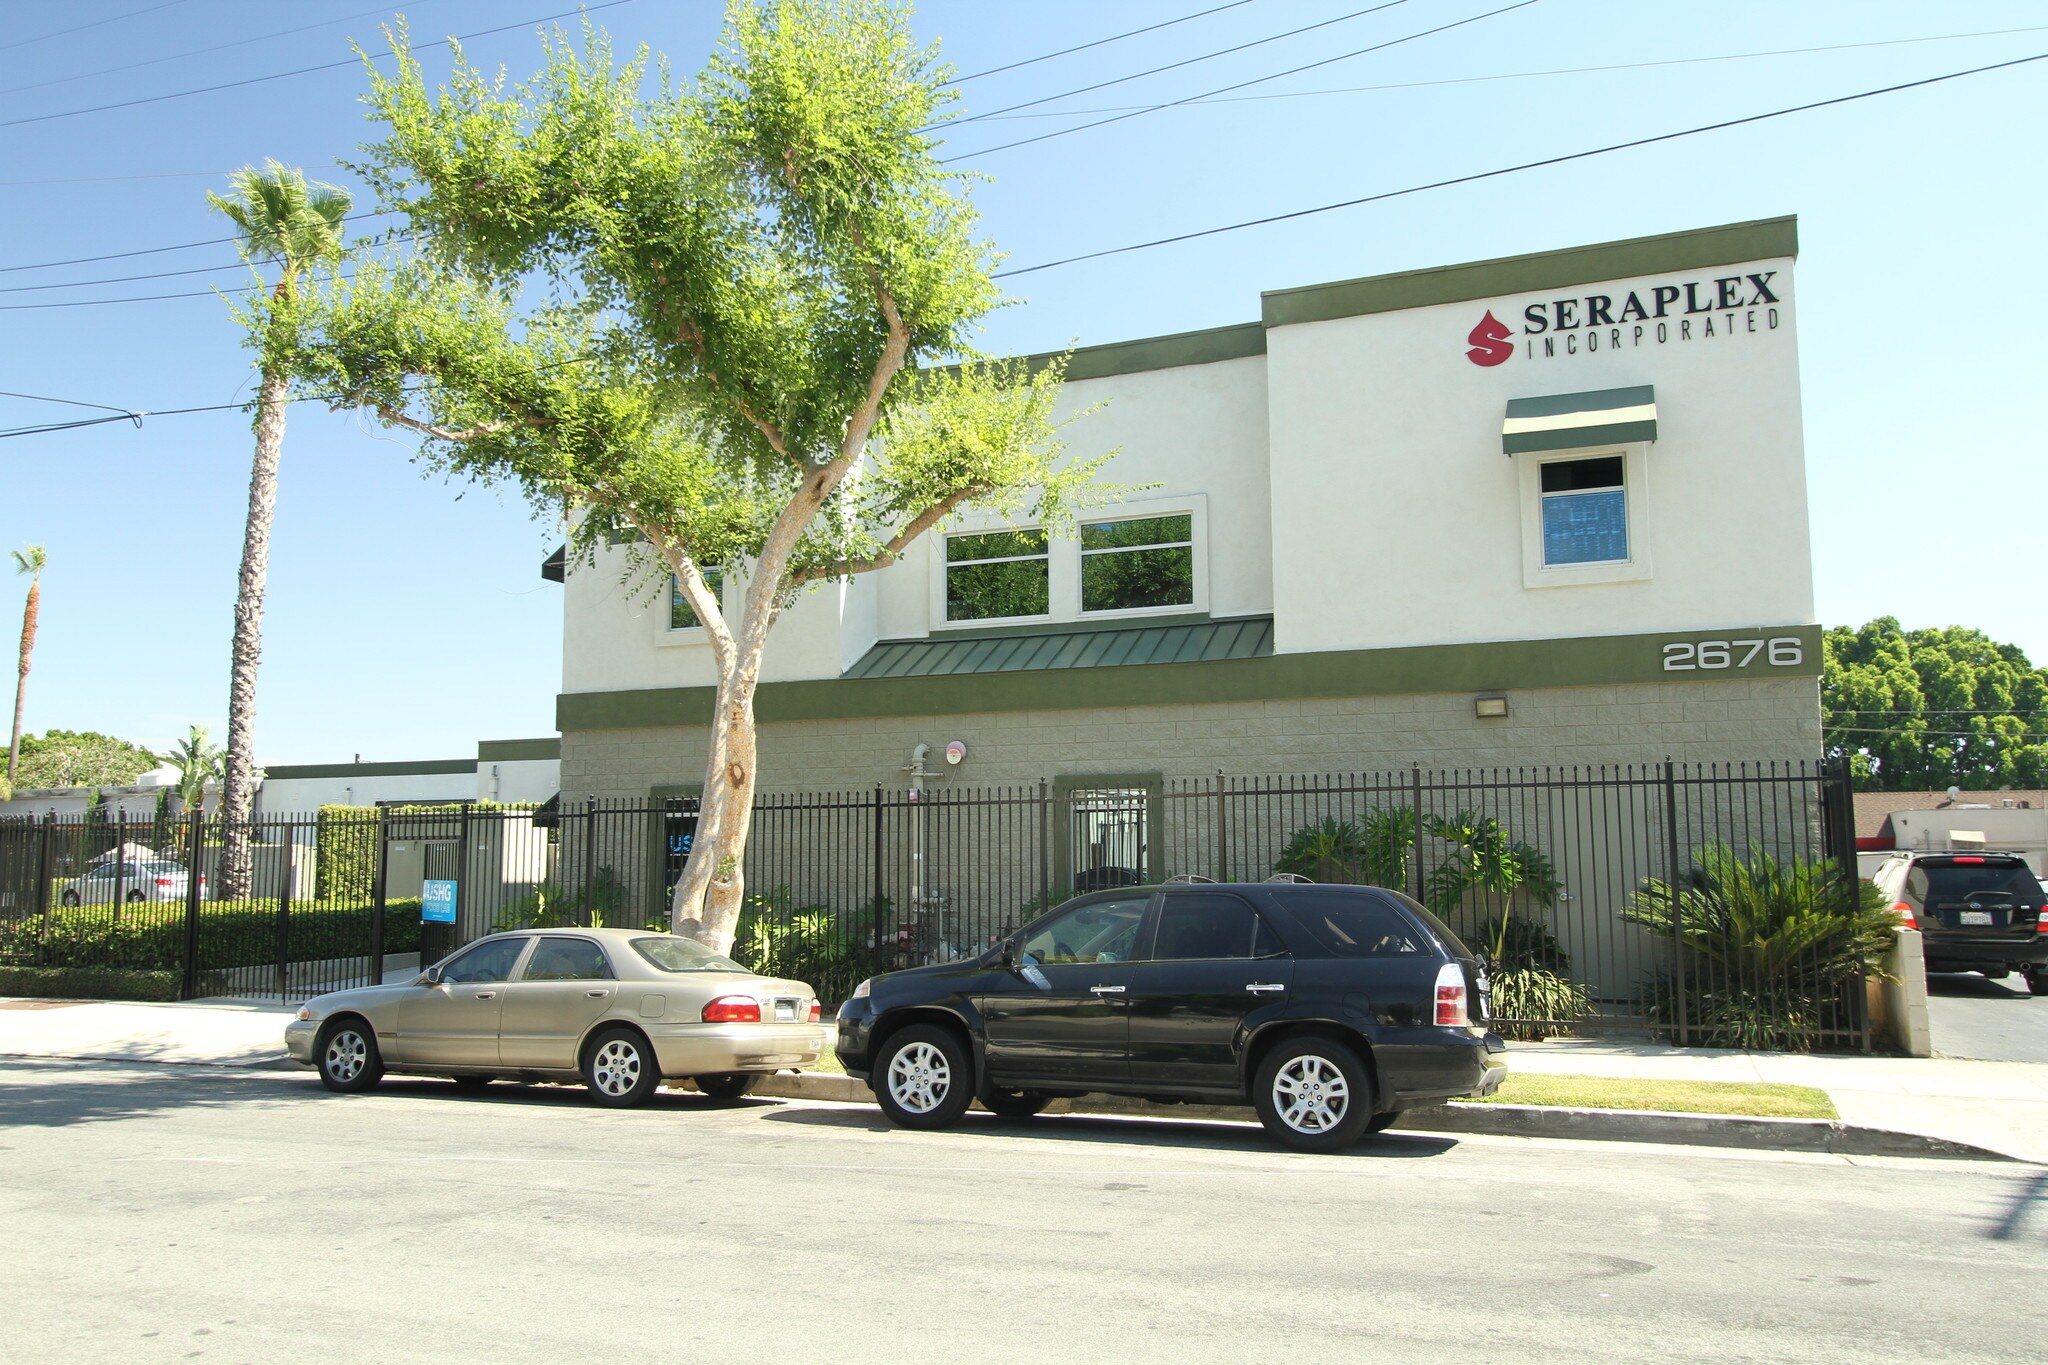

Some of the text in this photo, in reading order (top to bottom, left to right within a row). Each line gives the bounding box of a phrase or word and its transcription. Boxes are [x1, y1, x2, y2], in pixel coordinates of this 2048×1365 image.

[1524, 271, 1780, 335] SERAPLEX
[1527, 308, 1779, 360] INCORPORATED
[1662, 637, 1803, 671] 2676
[426, 883, 452, 902] USHG
